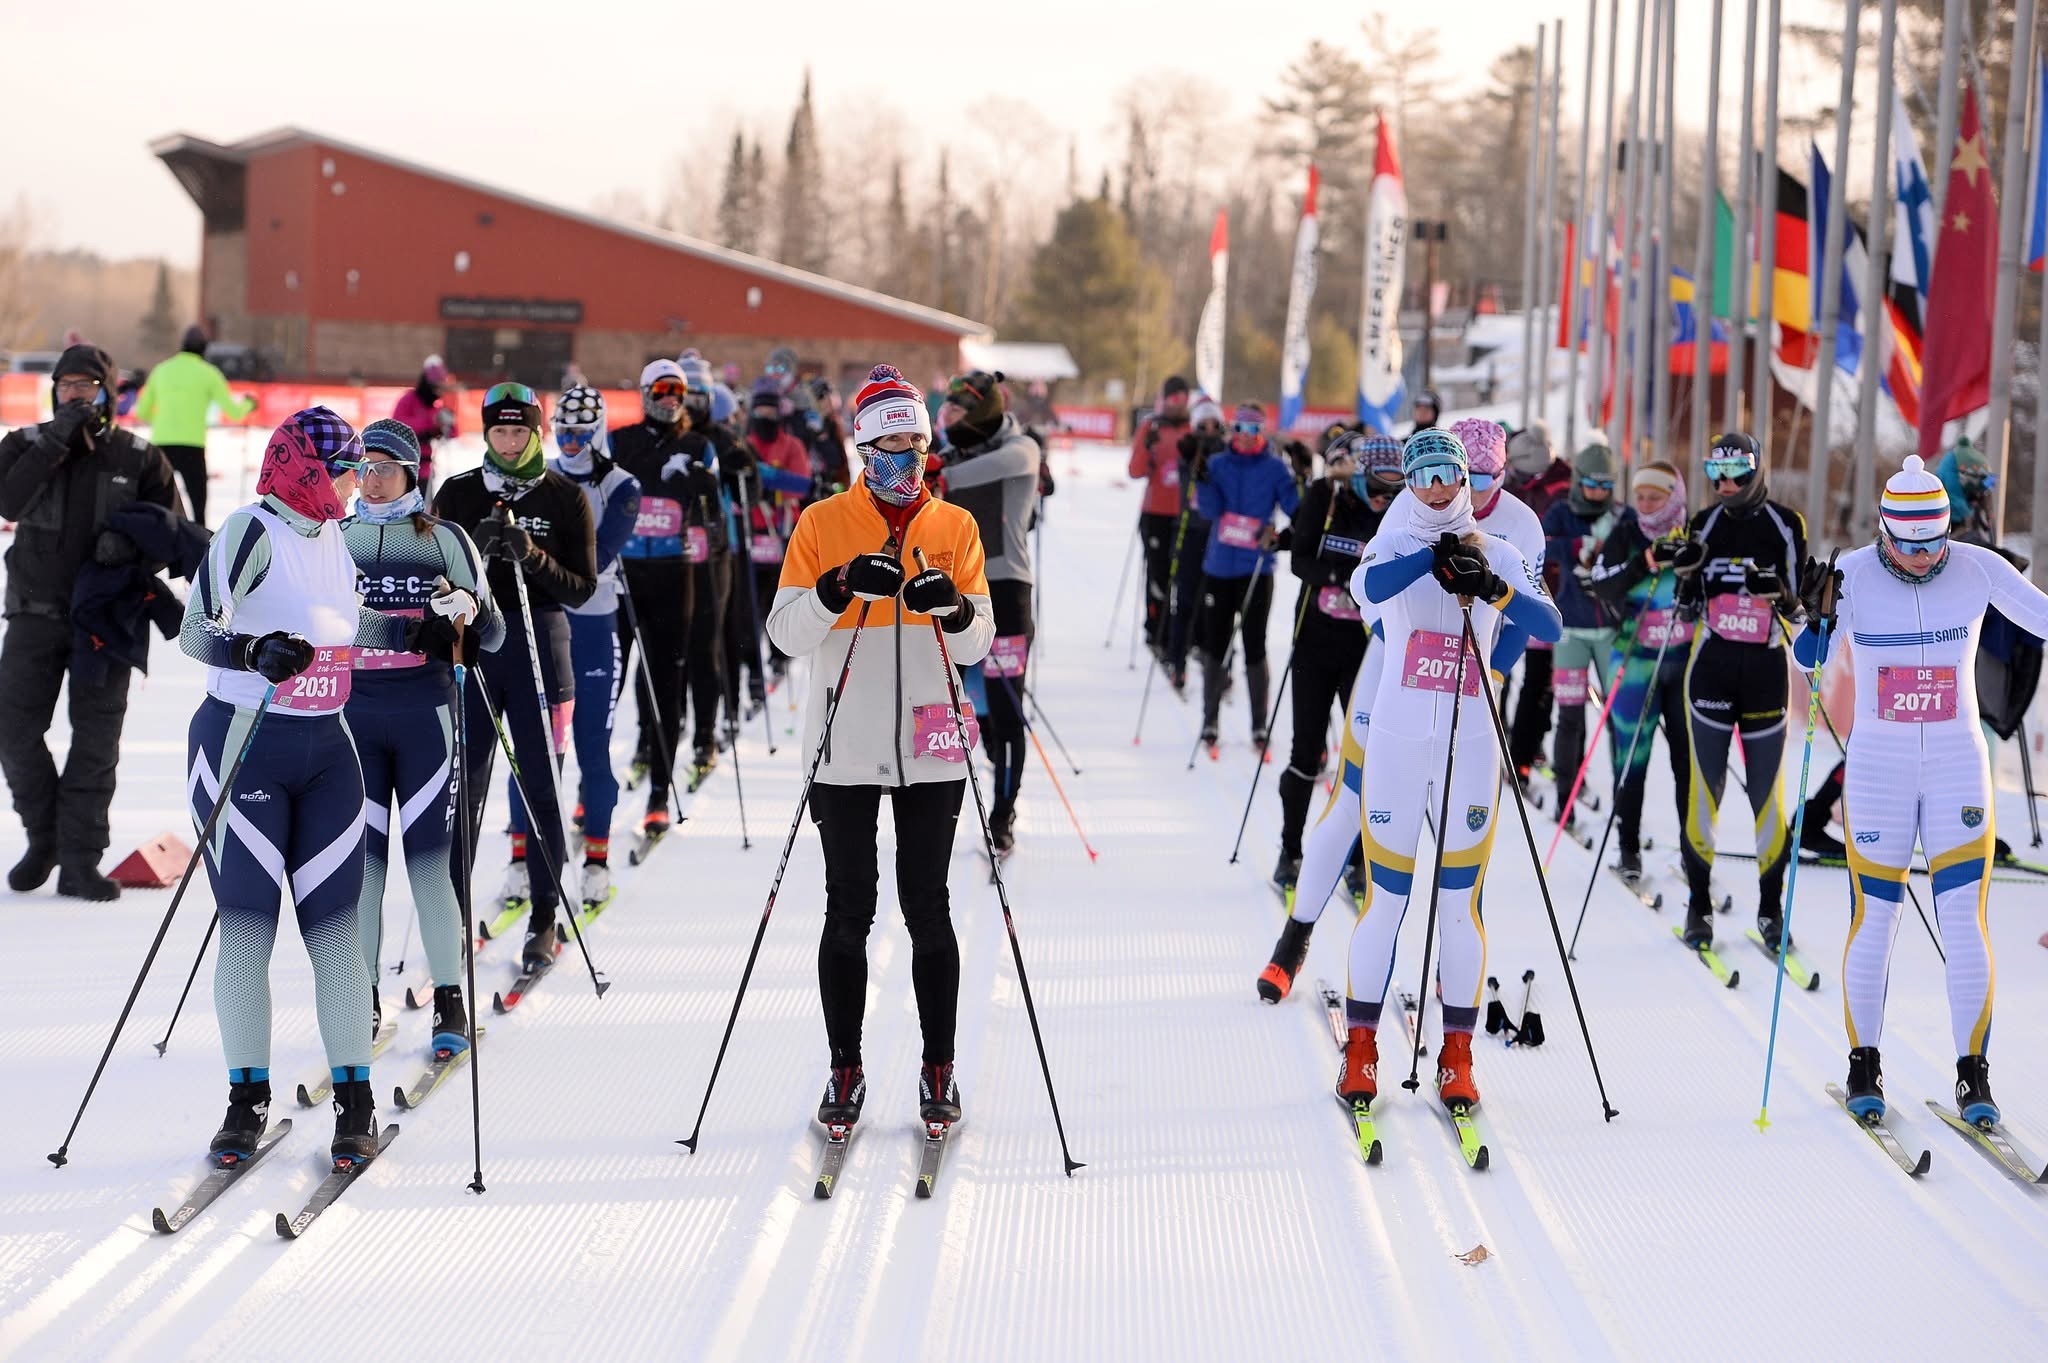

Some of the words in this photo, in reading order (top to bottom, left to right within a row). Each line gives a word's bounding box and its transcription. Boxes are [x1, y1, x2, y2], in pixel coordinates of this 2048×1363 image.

[1647, 623, 1685, 641] 200
[1717, 613, 1758, 634] 2048
[1444, 636, 1460, 649] DE
[1935, 625, 1969, 643] SAINTS
[318, 650, 333, 662] DE
[1917, 669, 1933, 681] DE
[291, 676, 337, 698] 2031
[1893, 692, 1942, 711] 2071
[927, 730, 969, 750] 204
